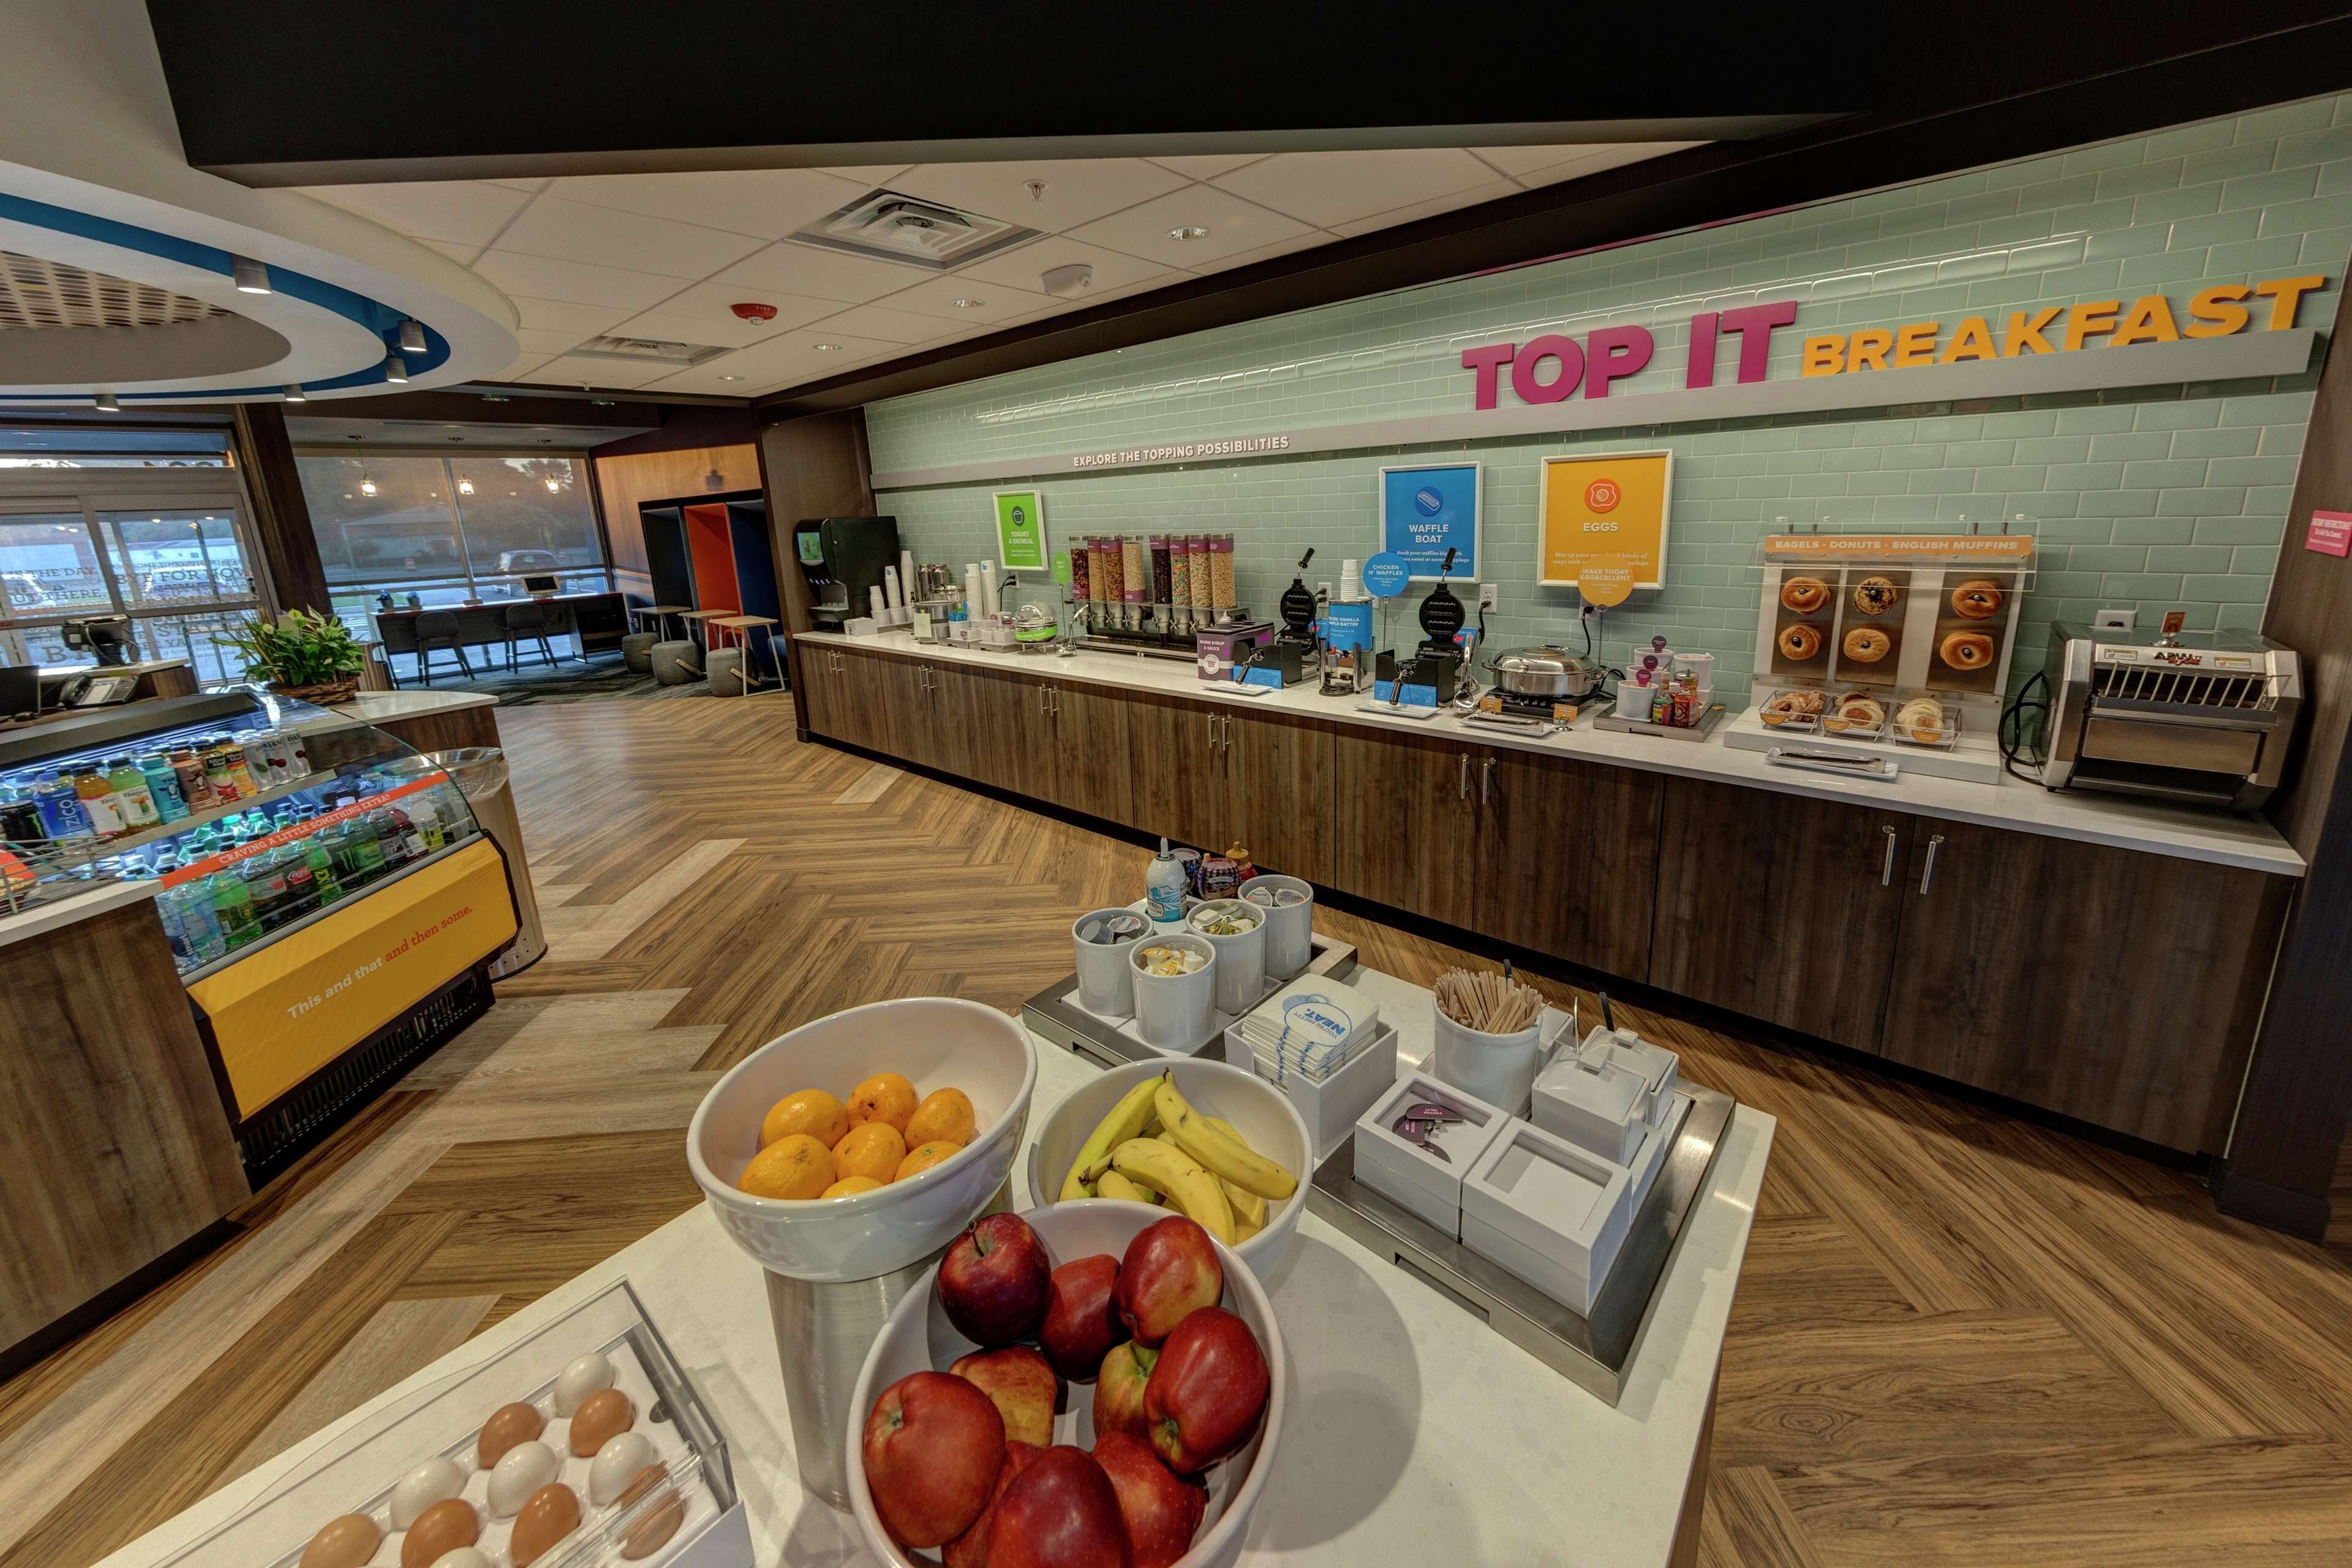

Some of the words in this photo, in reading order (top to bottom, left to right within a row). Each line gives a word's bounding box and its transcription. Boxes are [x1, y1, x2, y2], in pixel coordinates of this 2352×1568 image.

[1461, 325, 1655, 410] TOP
[1686, 300, 1796, 389] IT
[1801, 275, 2326, 378] BREAKFAST
[1074, 453, 1118, 467] EXPLORE
[1120, 451, 1140, 462] THE
[1144, 445, 1194, 460] TOPPING
[1197, 435, 1289, 456] POSSIBILITIES
[1409, 524, 1449, 533] WAFFLE
[1583, 522, 1618, 532] EGGS
[1775, 540, 1819, 549] BAGELS
[29, 568, 61, 578] THE
[160, 570, 200, 582] FOR
[41, 589, 107, 601] THERE.
[219, 840, 268, 864] CRAVING
[269, 837, 277, 845] A
[277, 824, 310, 842] LITTLE
[311, 804, 362, 829] SOMETHING
[362, 794, 391, 810] EXTRA?
[287, 994, 322, 1020] This
[325, 974, 353, 999] and
[354, 957, 383, 981] that
[385, 938, 410, 962] and
[411, 924, 439, 946] then
[440, 905, 473, 929] some.
[1292, 1011, 1316, 1025] PRETTY
[1305, 1008, 1346, 1036] NEAT.
[1315, 1022, 1338, 1039] YOU'RE
